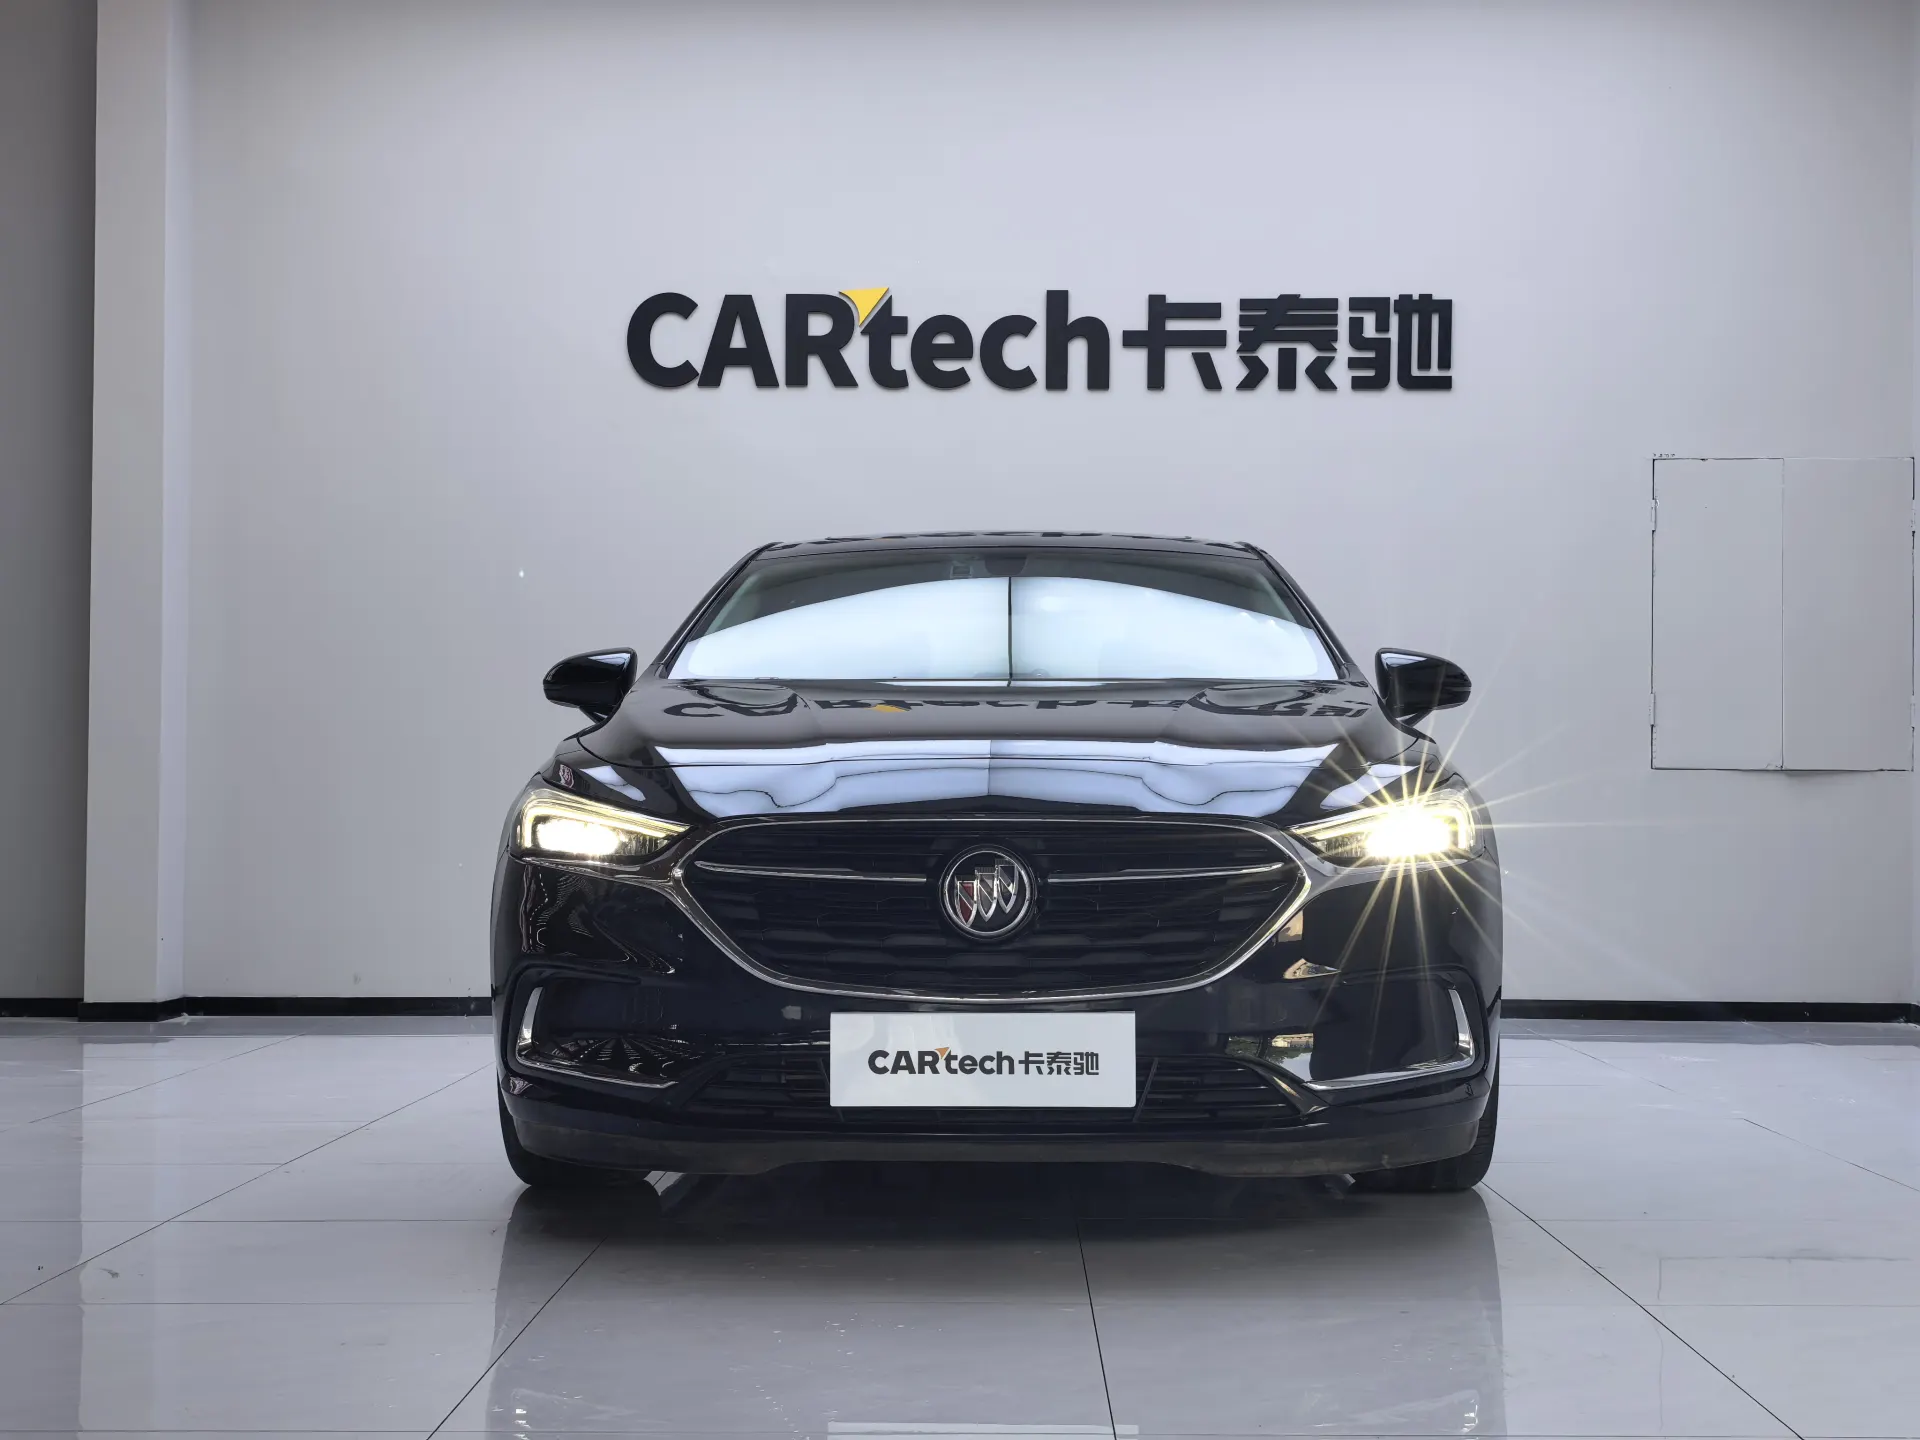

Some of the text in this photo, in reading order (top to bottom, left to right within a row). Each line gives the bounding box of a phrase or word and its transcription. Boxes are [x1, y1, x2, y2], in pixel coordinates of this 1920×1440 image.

[626, 289, 1453, 391] CARtech 卡泰驰
[867, 1048, 1099, 1076] CARtech 卡泰驰
